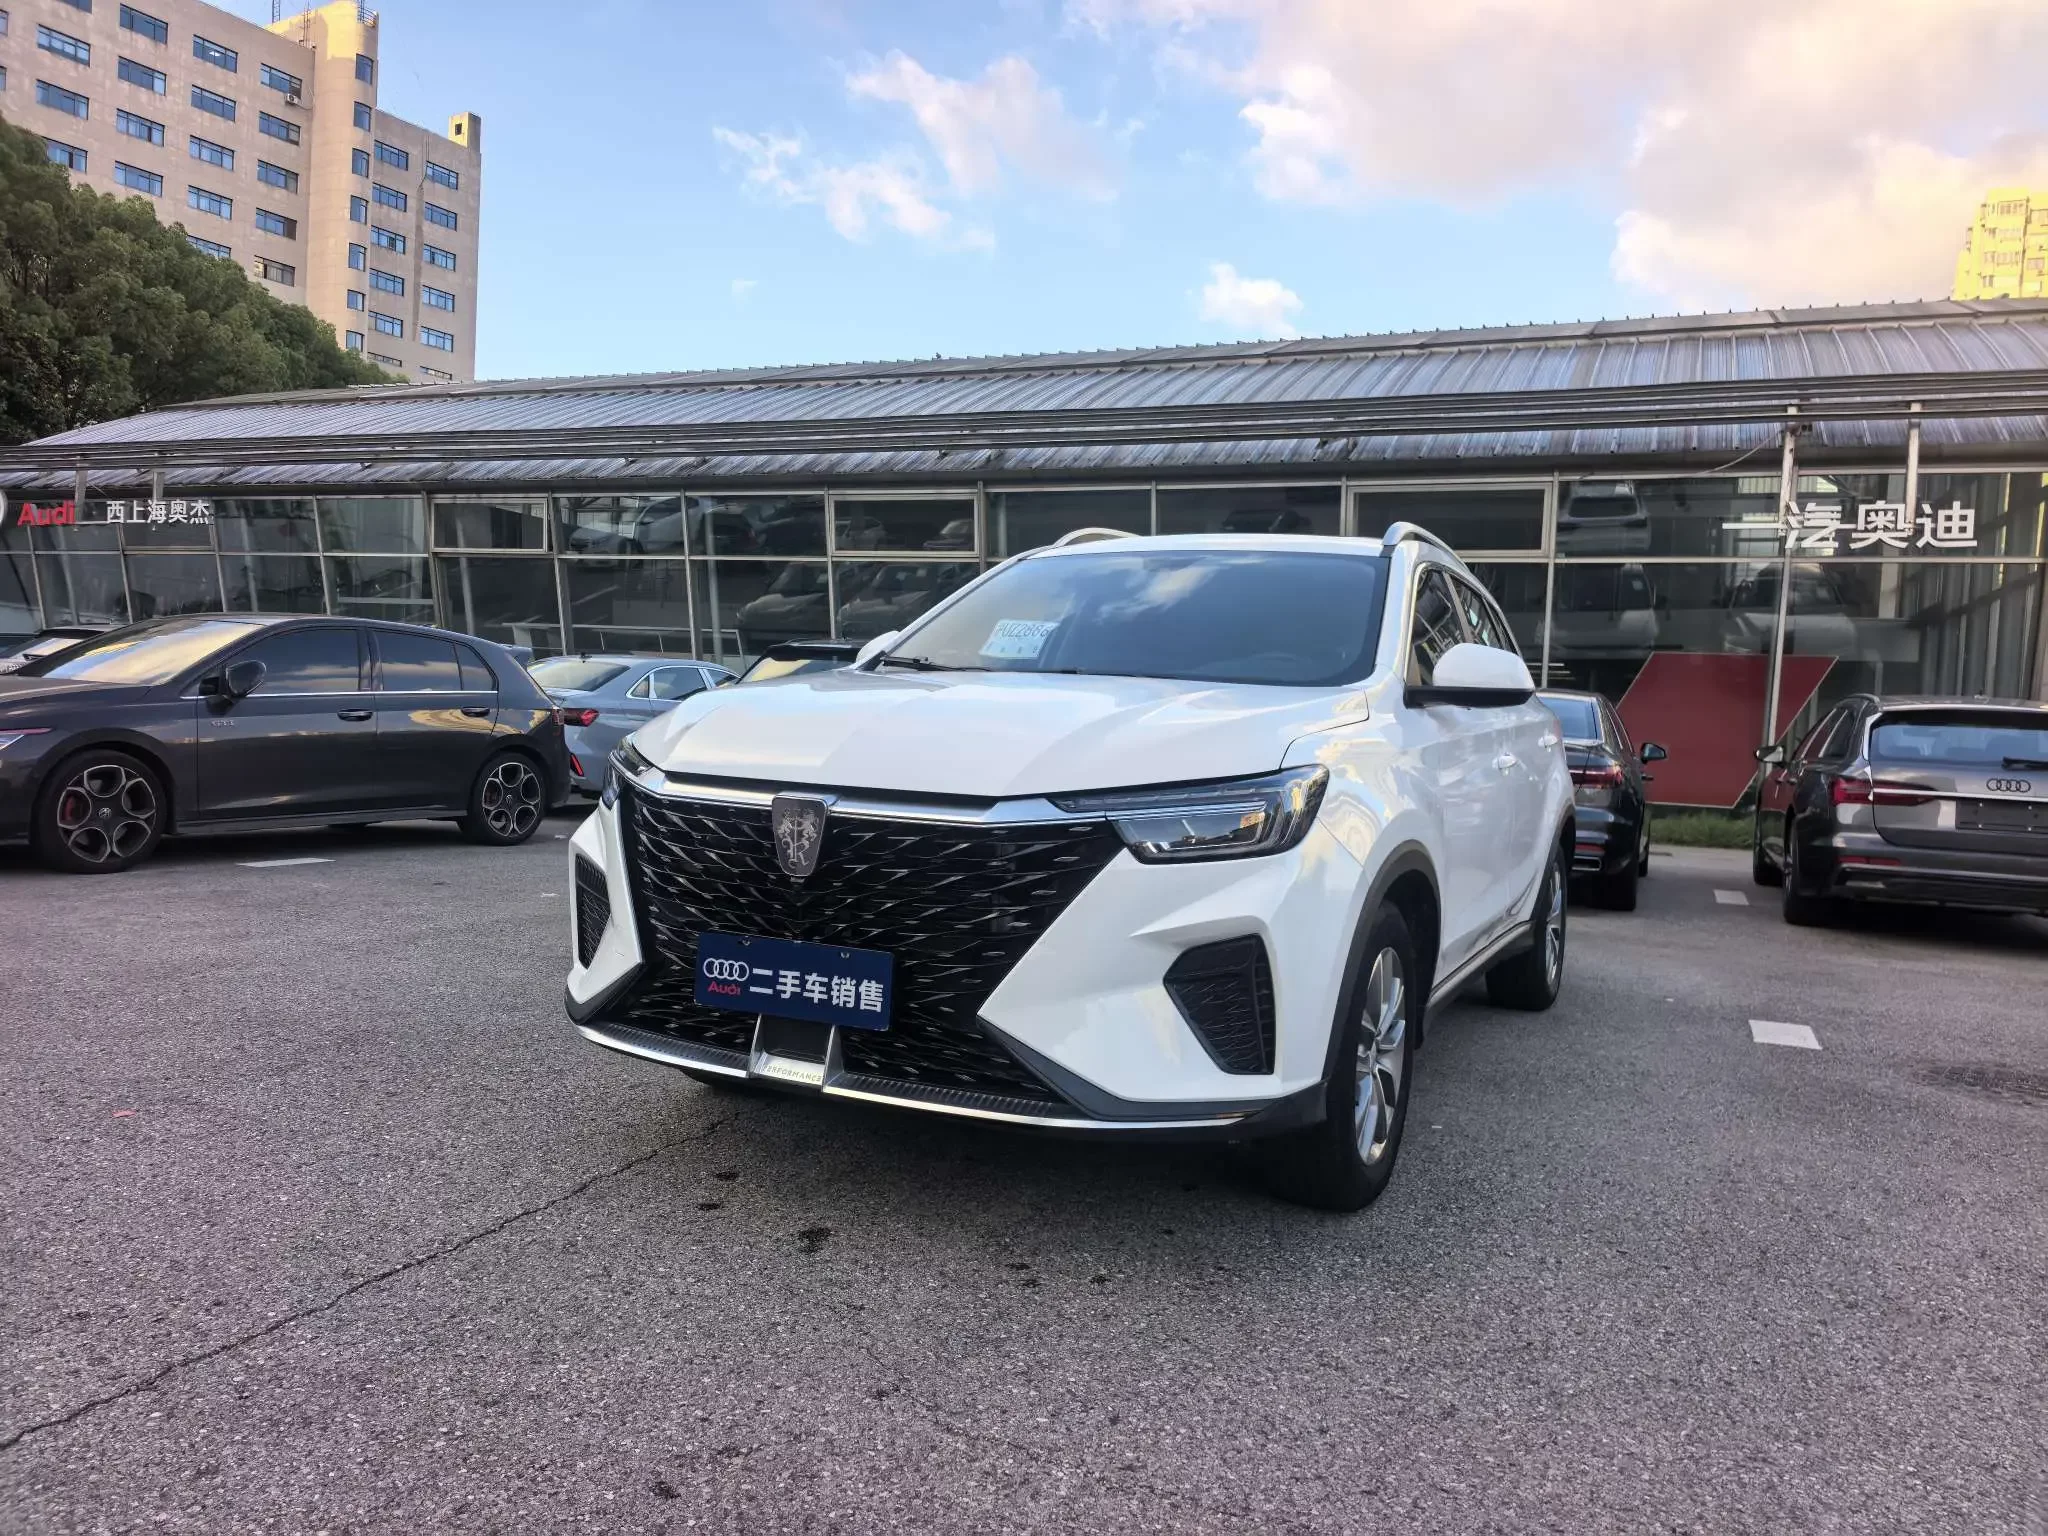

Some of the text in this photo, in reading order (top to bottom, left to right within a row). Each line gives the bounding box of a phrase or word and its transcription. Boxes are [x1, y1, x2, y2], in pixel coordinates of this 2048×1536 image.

[18, 501, 75, 525] Audi
[106, 499, 210, 524] 西上海奥杰
[1722, 500, 1977, 548] 一汽奥迪
[707, 981, 741, 996] Audi
[750, 968, 884, 1013] 二手车销售
[763, 1063, 822, 1082] PERFORMANCE
